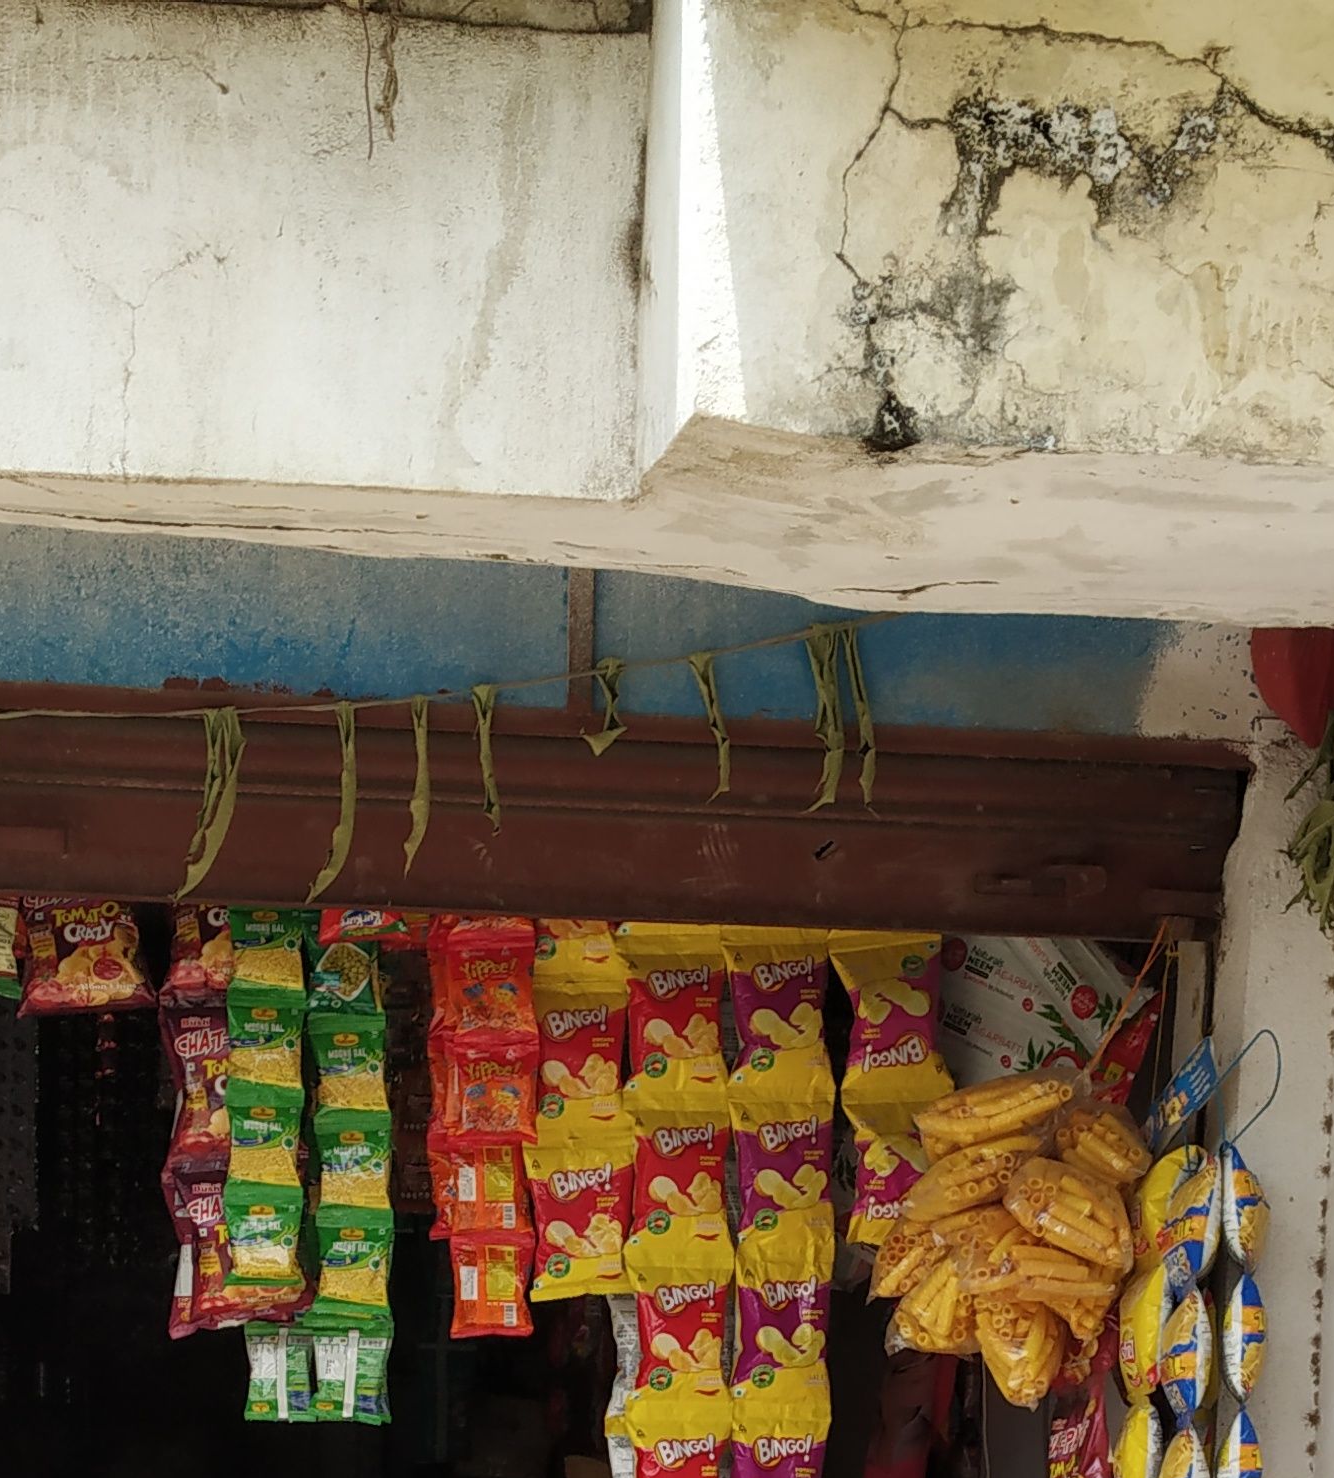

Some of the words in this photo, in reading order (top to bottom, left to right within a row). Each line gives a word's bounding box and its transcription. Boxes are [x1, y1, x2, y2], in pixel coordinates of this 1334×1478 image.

[63, 921, 114, 943] CRAZY
[651, 965, 711, 997] BINGO!
[757, 955, 814, 989] BINGO!
[546, 1005, 607, 1038] BINGO!
[862, 1036, 925, 1073] BINGO!
[657, 1123, 715, 1154] BINGO!
[761, 1115, 817, 1150] BINGO!
[551, 1163, 613, 1197] BINGO!
[657, 1281, 716, 1311] BINGO!
[764, 1276, 817, 1307] BINGO!
[657, 1434, 716, 1467] BINGO!
[756, 1435, 813, 1464] BINGO!
